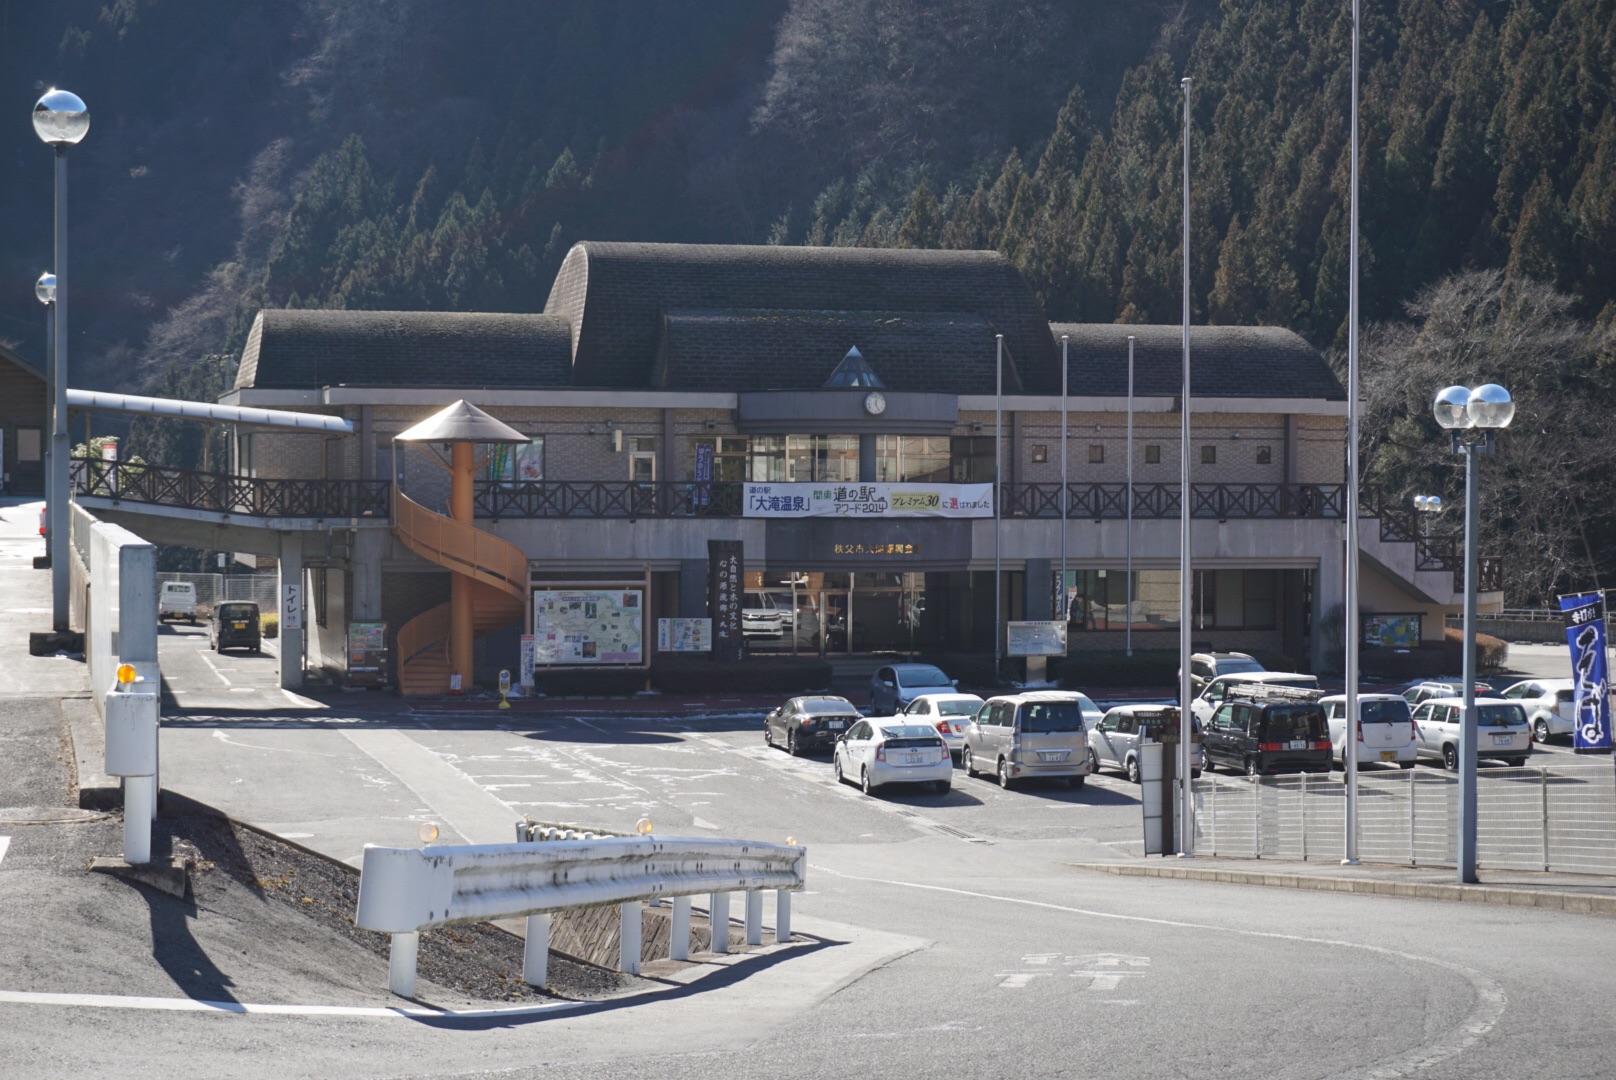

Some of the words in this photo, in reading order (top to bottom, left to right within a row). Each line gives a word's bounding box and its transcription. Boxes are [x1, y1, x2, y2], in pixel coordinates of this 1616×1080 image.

[749, 486, 771, 494] 道の駅
[834, 486, 876, 501] 道の駅
[287, 585, 297, 613] トイレ
